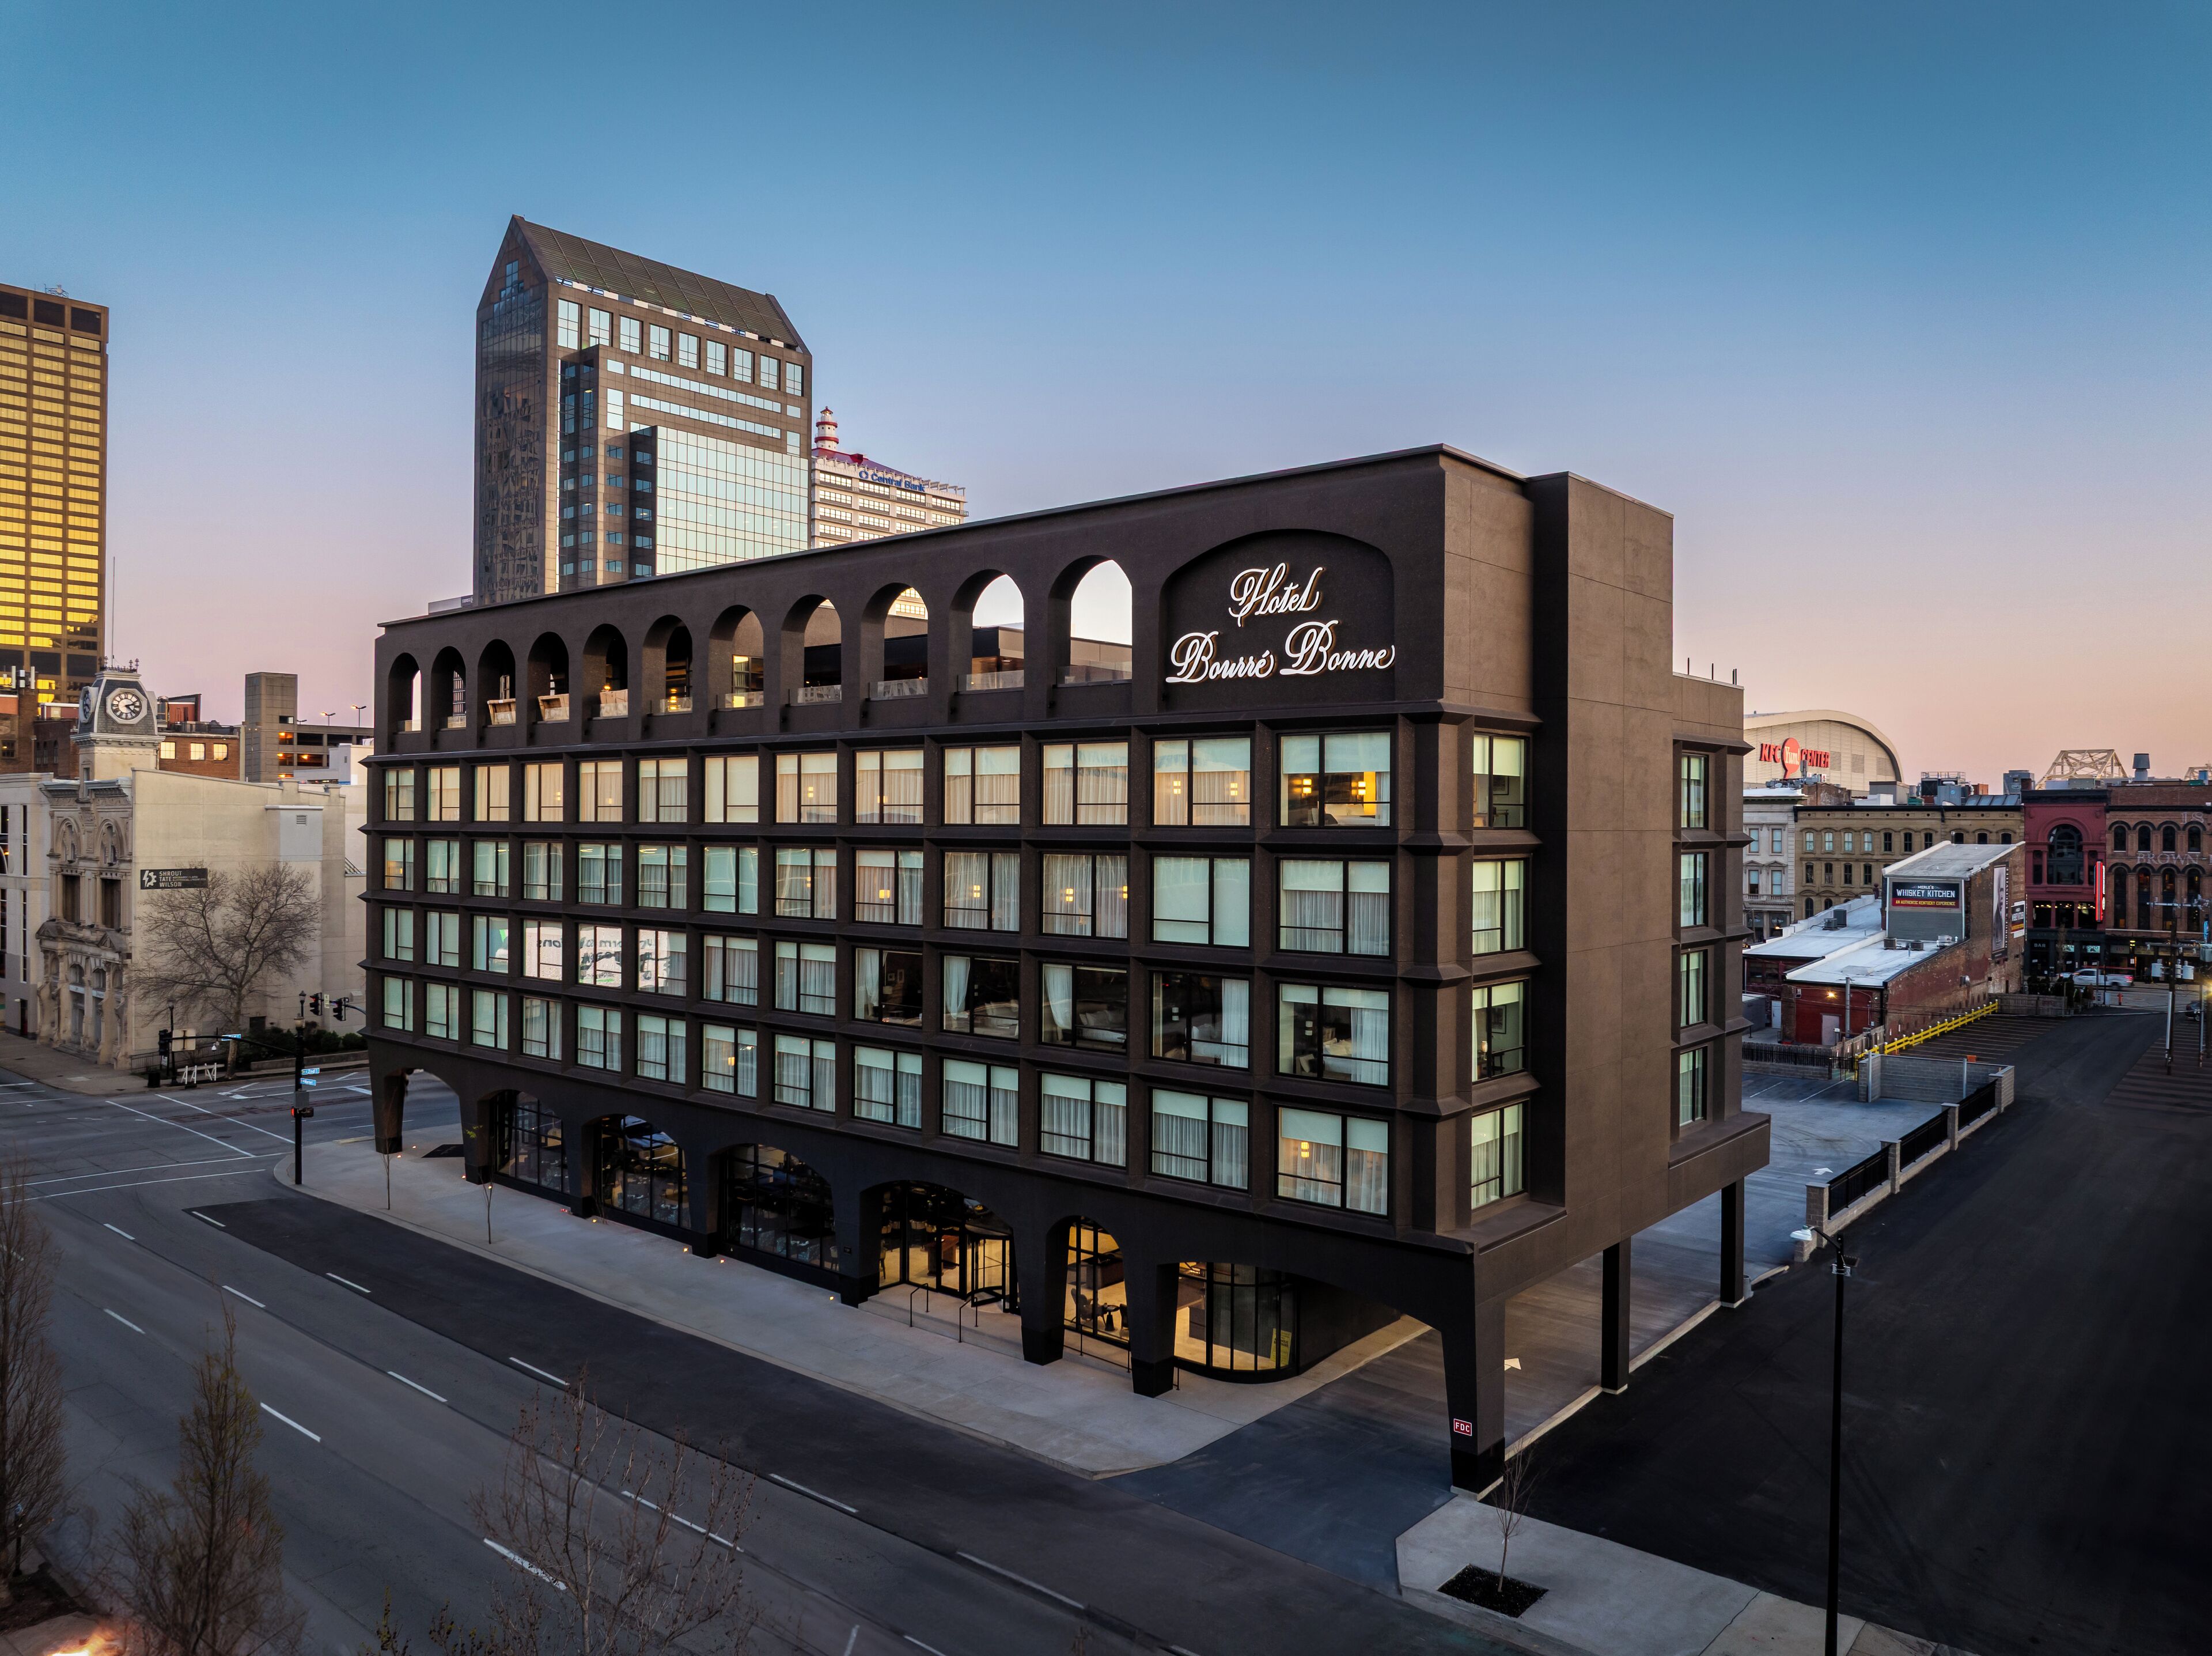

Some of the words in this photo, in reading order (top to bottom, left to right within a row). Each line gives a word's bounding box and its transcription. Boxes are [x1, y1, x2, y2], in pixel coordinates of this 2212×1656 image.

[871, 473, 902, 486] Central
[905, 481, 926, 492] Bank
[1229, 562, 1324, 627] Hotel
[1165, 631, 1274, 683] Bourré
[1279, 620, 1395, 675] Bonne
[1760, 743, 1781, 763] KFC
[1785, 746, 1800, 765] Yum!
[1801, 748, 1830, 768] CENTER
[1455, 1422, 1470, 1433] FDC
